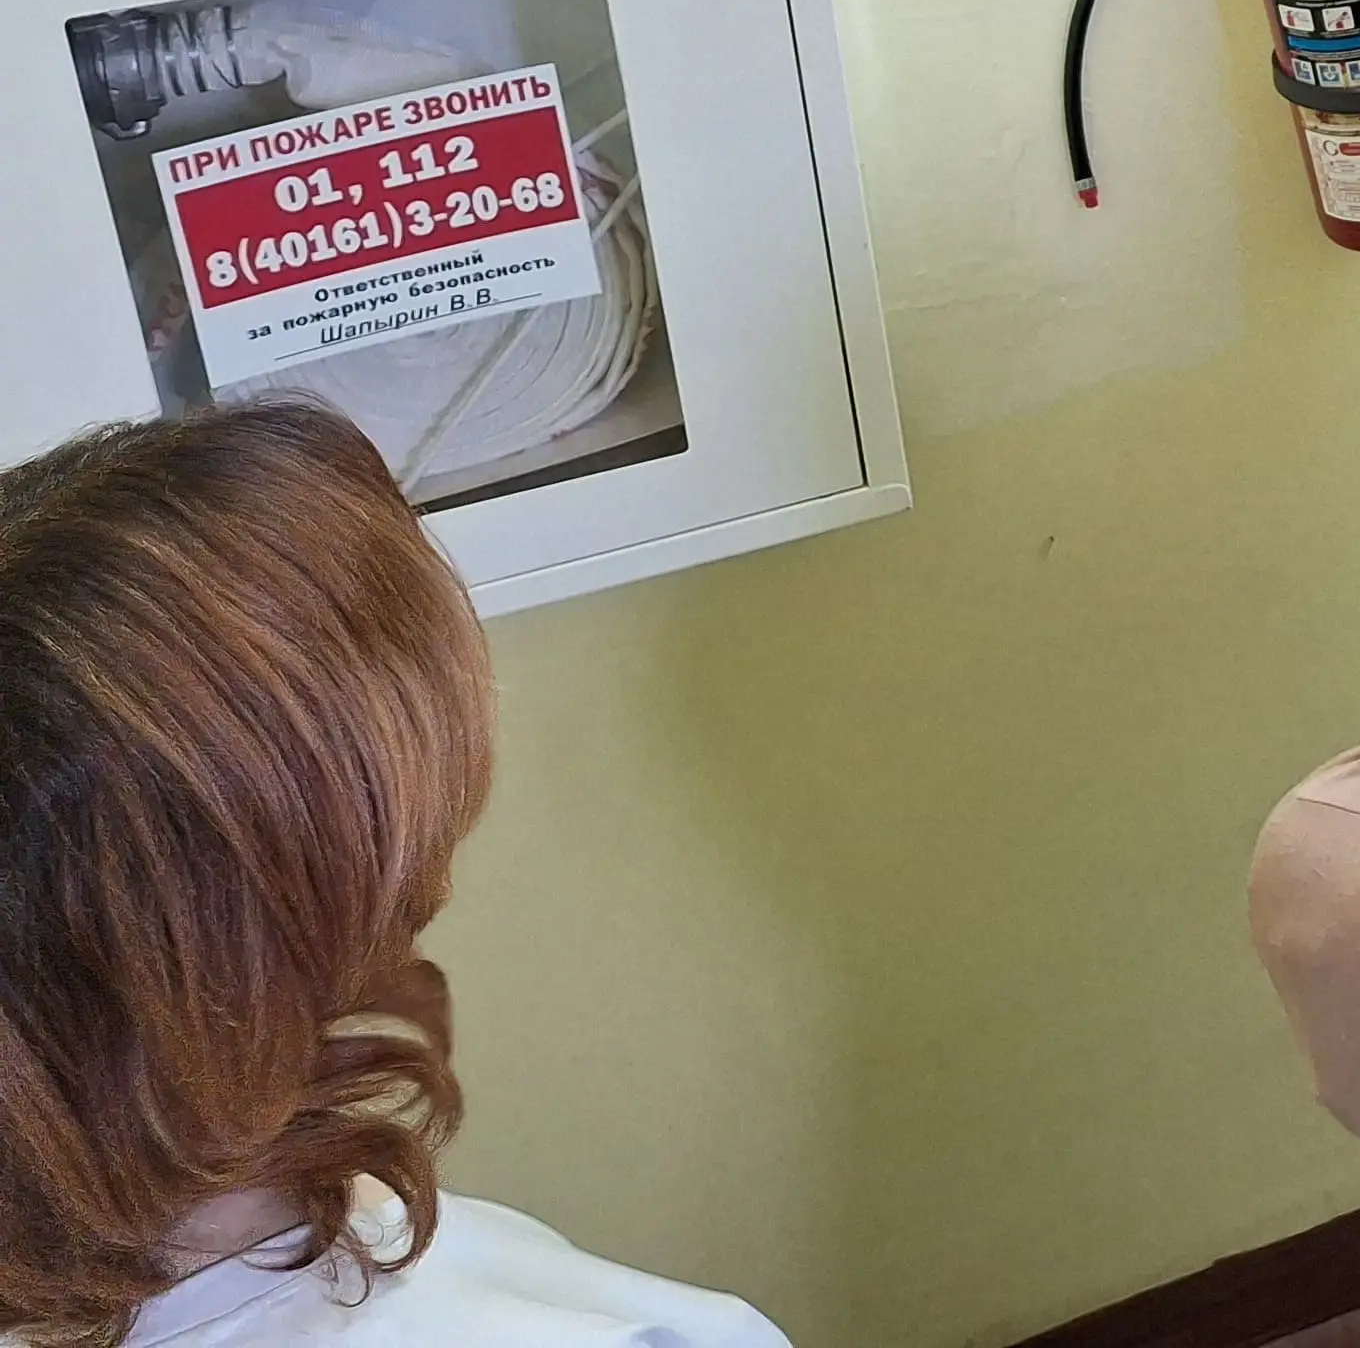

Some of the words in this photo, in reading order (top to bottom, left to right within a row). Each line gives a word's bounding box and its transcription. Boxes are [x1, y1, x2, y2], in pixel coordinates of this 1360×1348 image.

[168, 144, 241, 184] ПРИ
[249, 106, 396, 163] ПОЖАРЕ
[403, 76, 551, 125] ЗВОНИТЬ
[274, 166, 364, 213] 01,
[379, 135, 480, 189] 112
[205, 172, 565, 289] 8(40161)3-20-68
[247, 325, 272, 340] за
[283, 290, 398, 330] пожарную
[408, 256, 556, 297] безопасность
[314, 250, 485, 303] Ответственный
[320, 302, 440, 345] Шапырин
